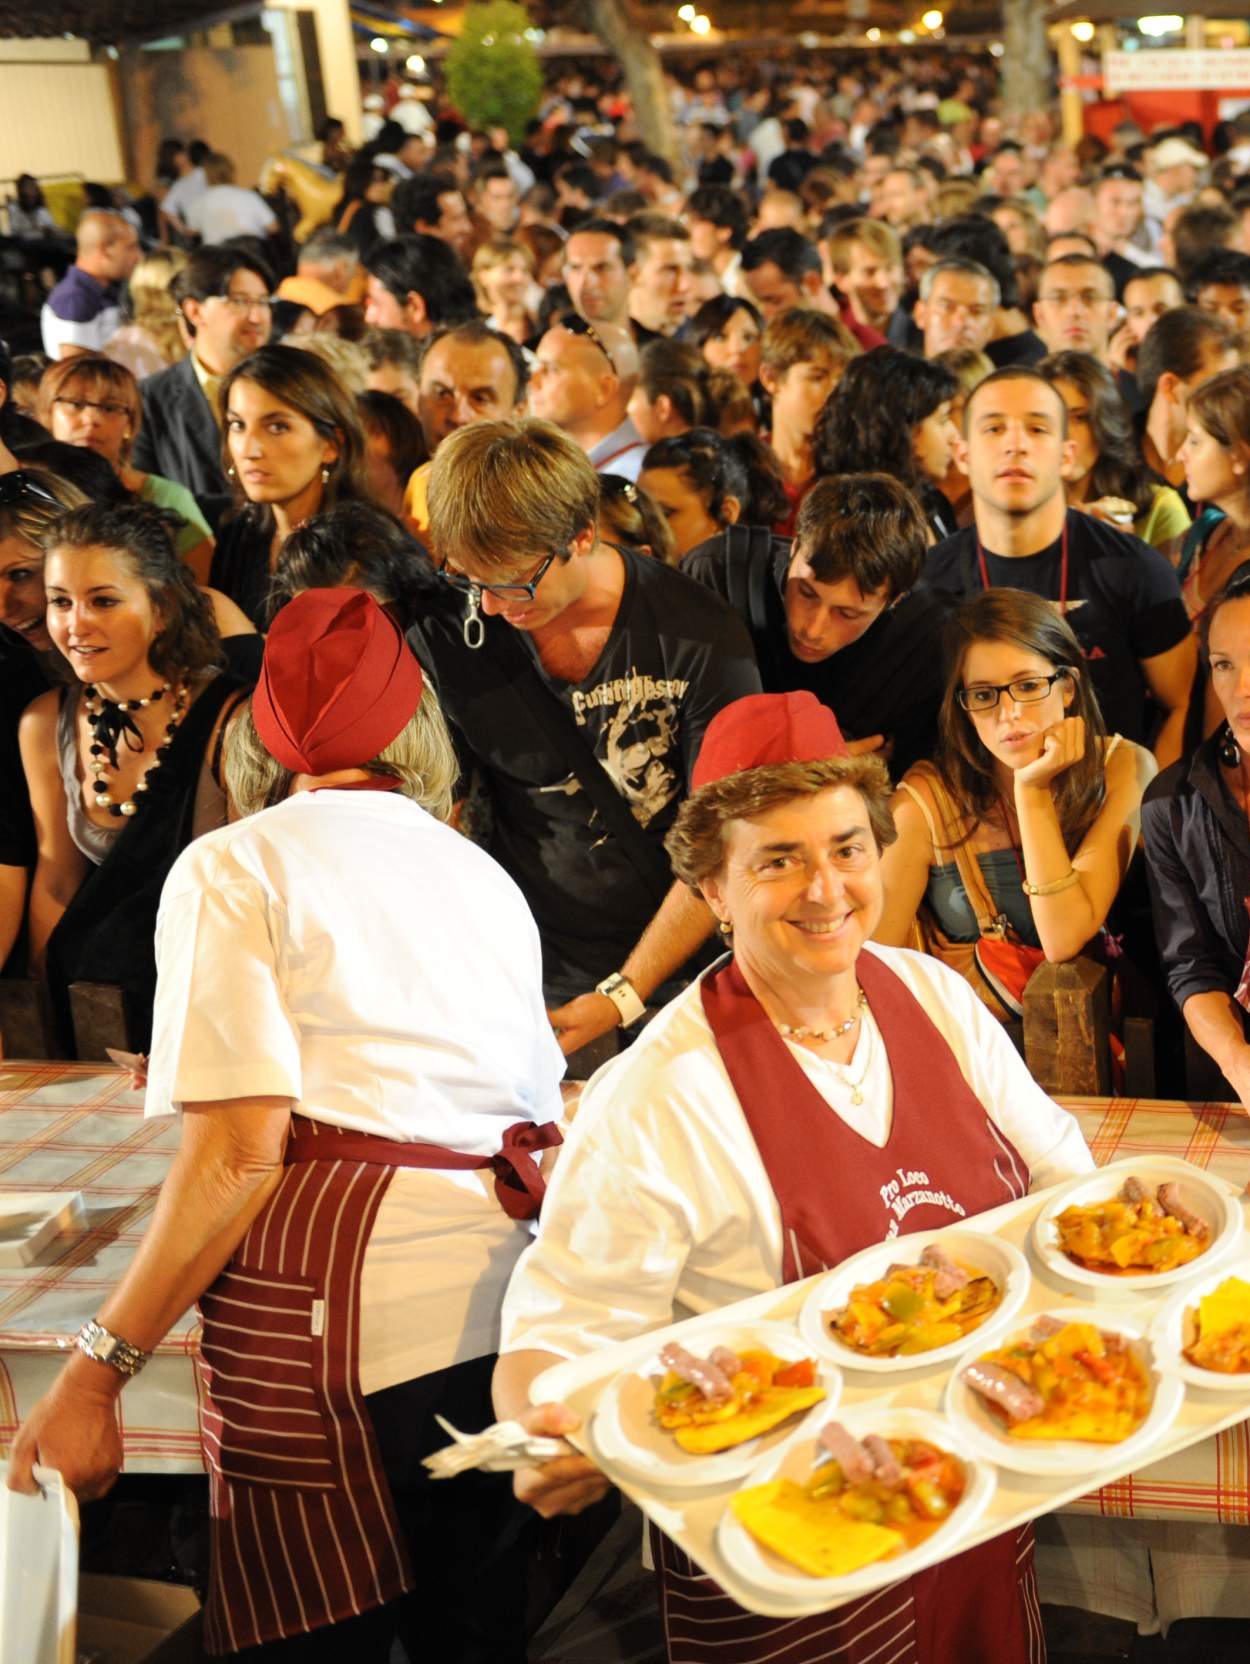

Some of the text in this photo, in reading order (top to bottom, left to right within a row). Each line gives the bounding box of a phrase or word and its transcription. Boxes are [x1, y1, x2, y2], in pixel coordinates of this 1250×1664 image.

[880, 1168, 930, 1209] Pro Loco
[891, 1190, 966, 1221] Marzanotto
